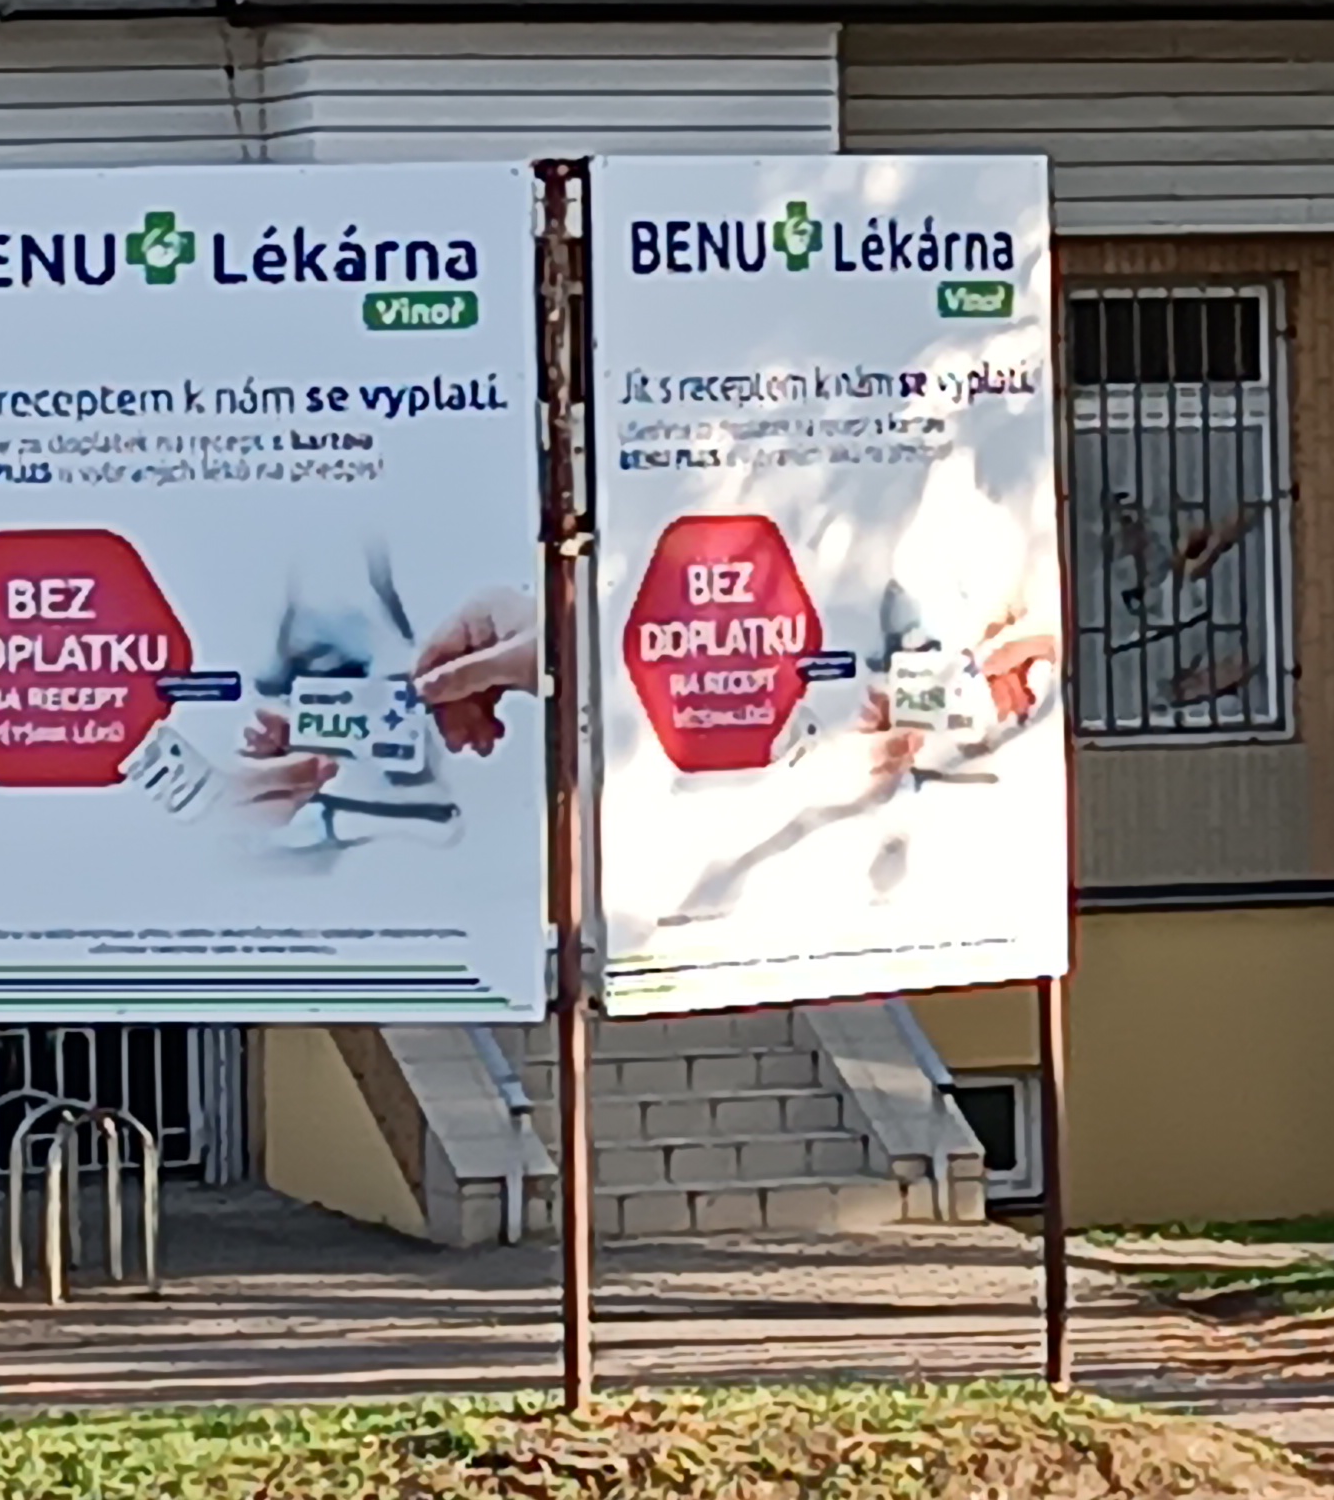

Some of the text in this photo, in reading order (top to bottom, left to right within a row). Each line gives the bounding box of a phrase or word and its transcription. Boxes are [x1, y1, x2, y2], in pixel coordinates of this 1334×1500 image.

[212, 224, 478, 284] Lékárna
[632, 216, 1014, 274] BENU Lékárna
[375, 296, 467, 325] Vinoř
[184, 379, 206, 414] k
[216, 376, 295, 415] nám
[306, 387, 349, 412] se
[8, 578, 97, 620] BEZ
[687, 560, 755, 606] BEZ
[640, 612, 807, 663] DOPLATKU
